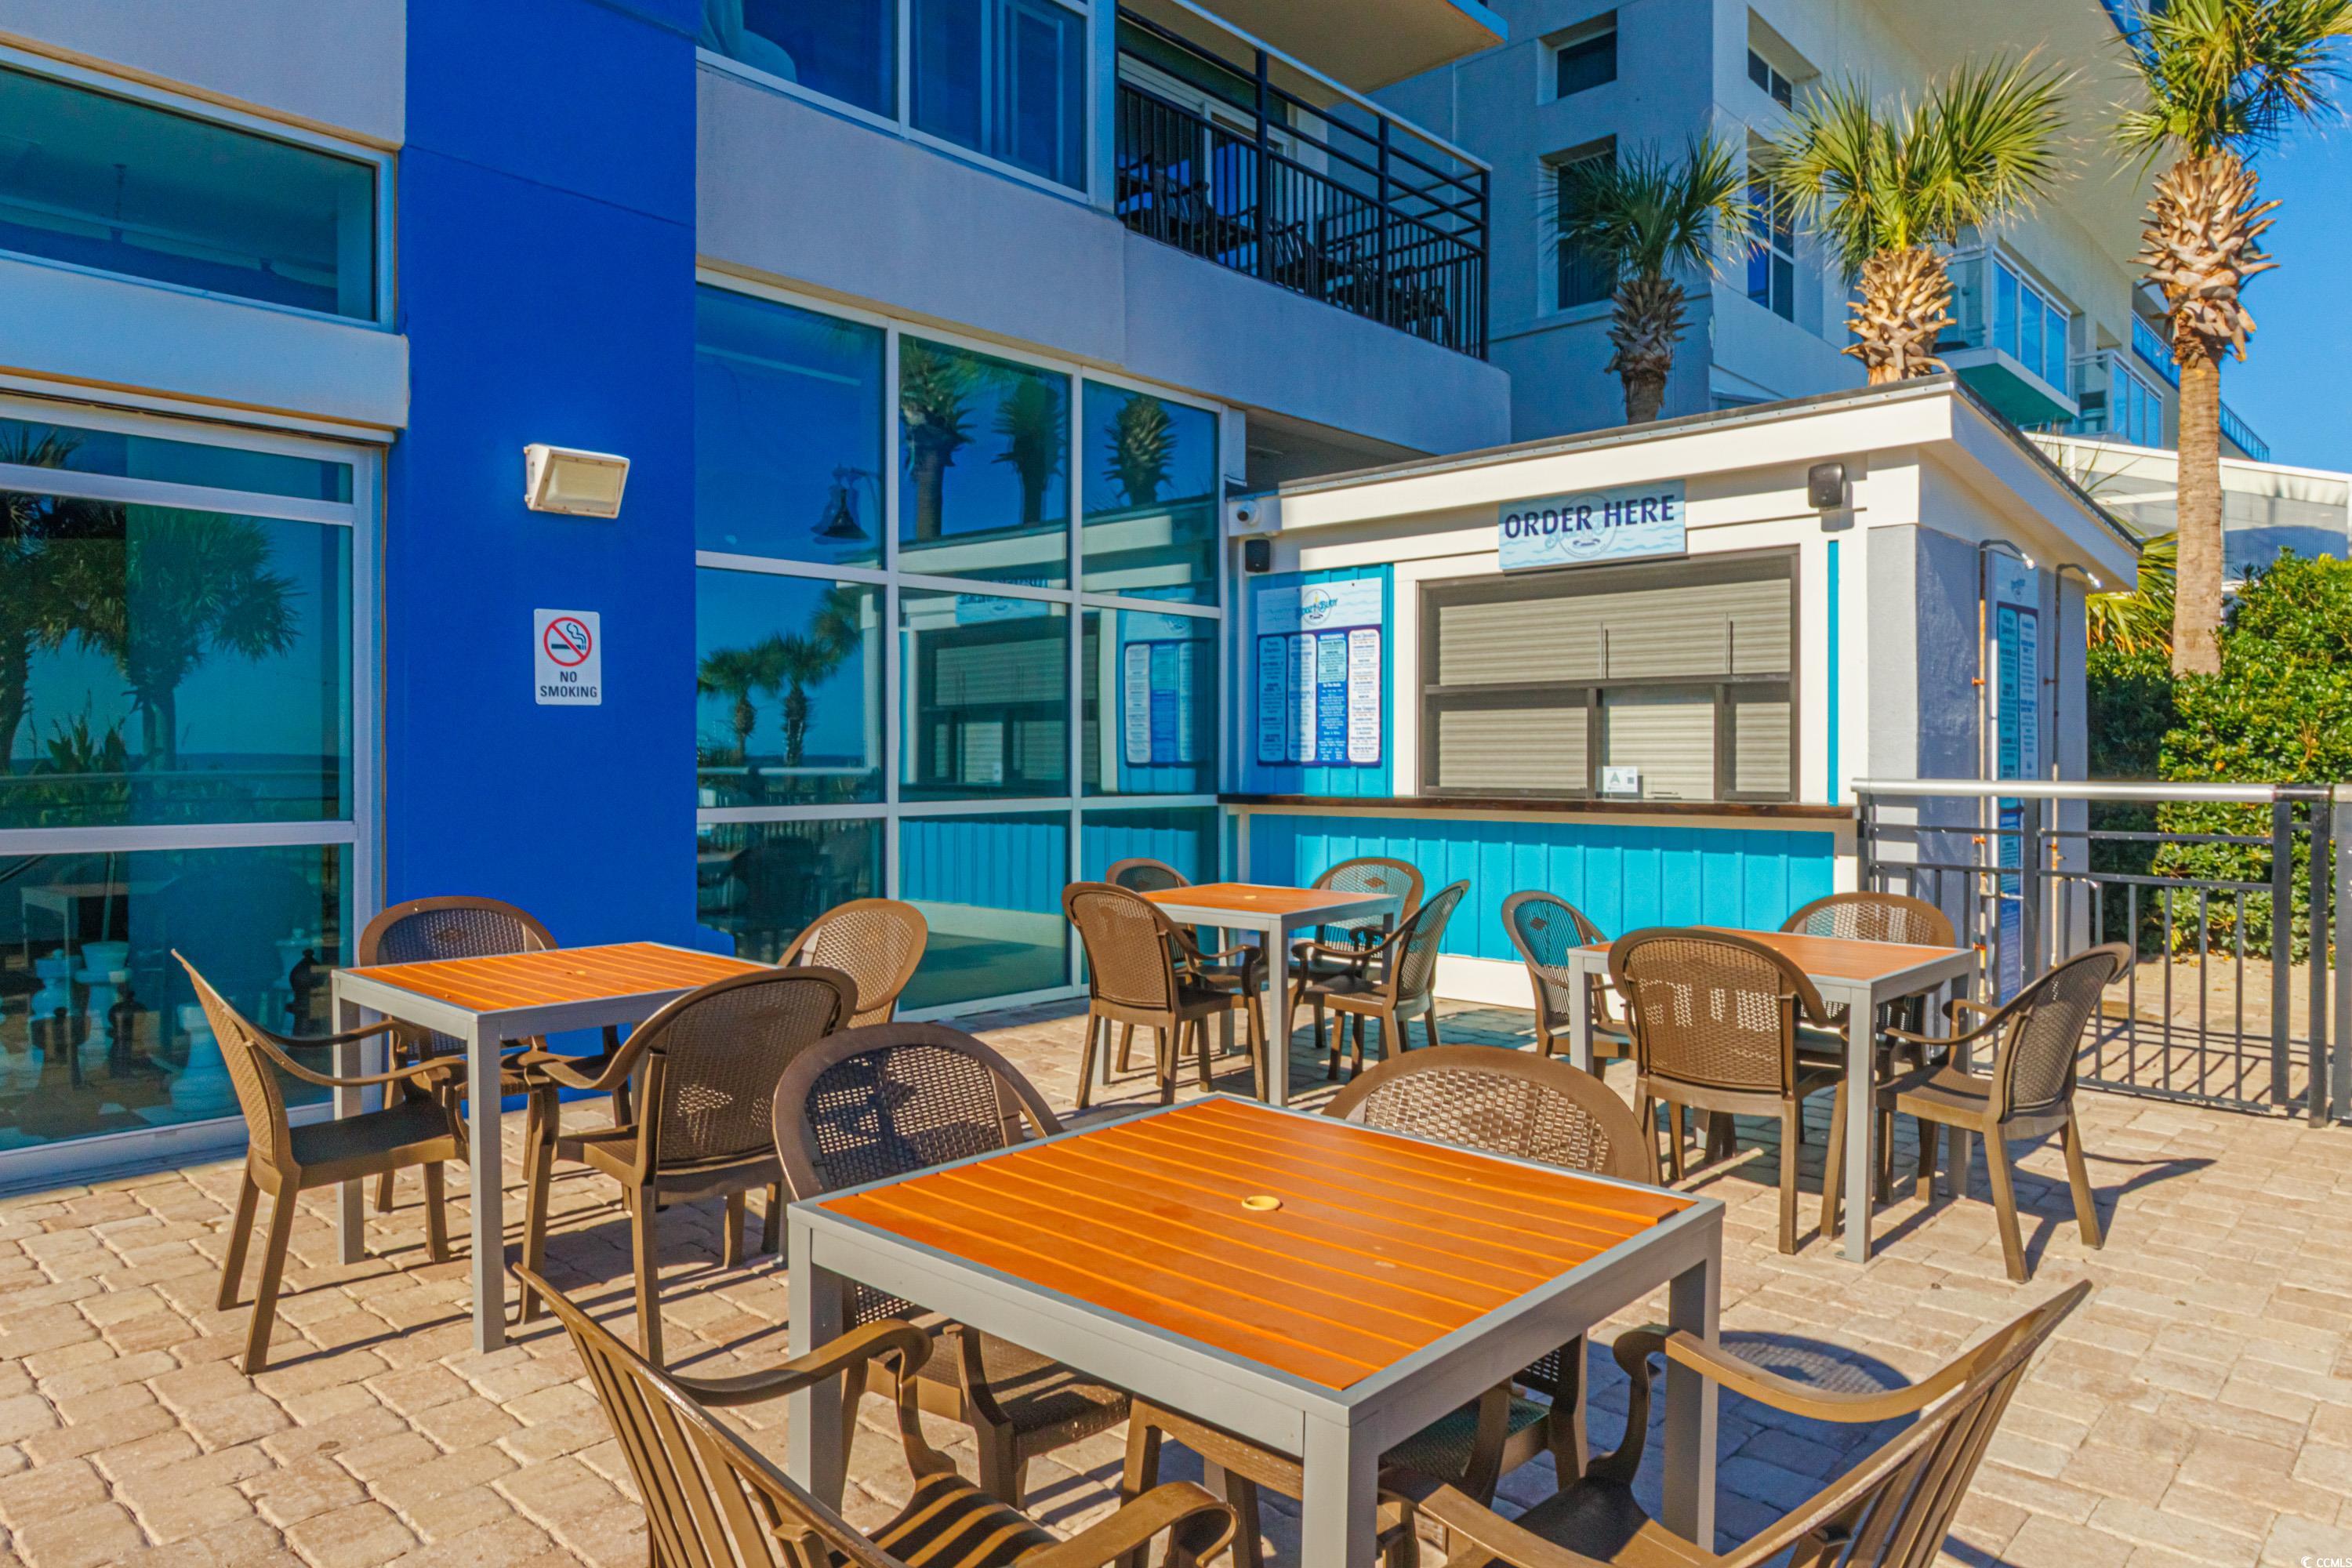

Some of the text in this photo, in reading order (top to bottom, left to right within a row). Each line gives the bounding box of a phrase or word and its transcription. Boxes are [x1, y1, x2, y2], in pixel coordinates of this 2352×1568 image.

[1504, 495, 1675, 539] ORDER HERE
[560, 671, 577, 683] NO
[540, 686, 597, 698] SMOKING
